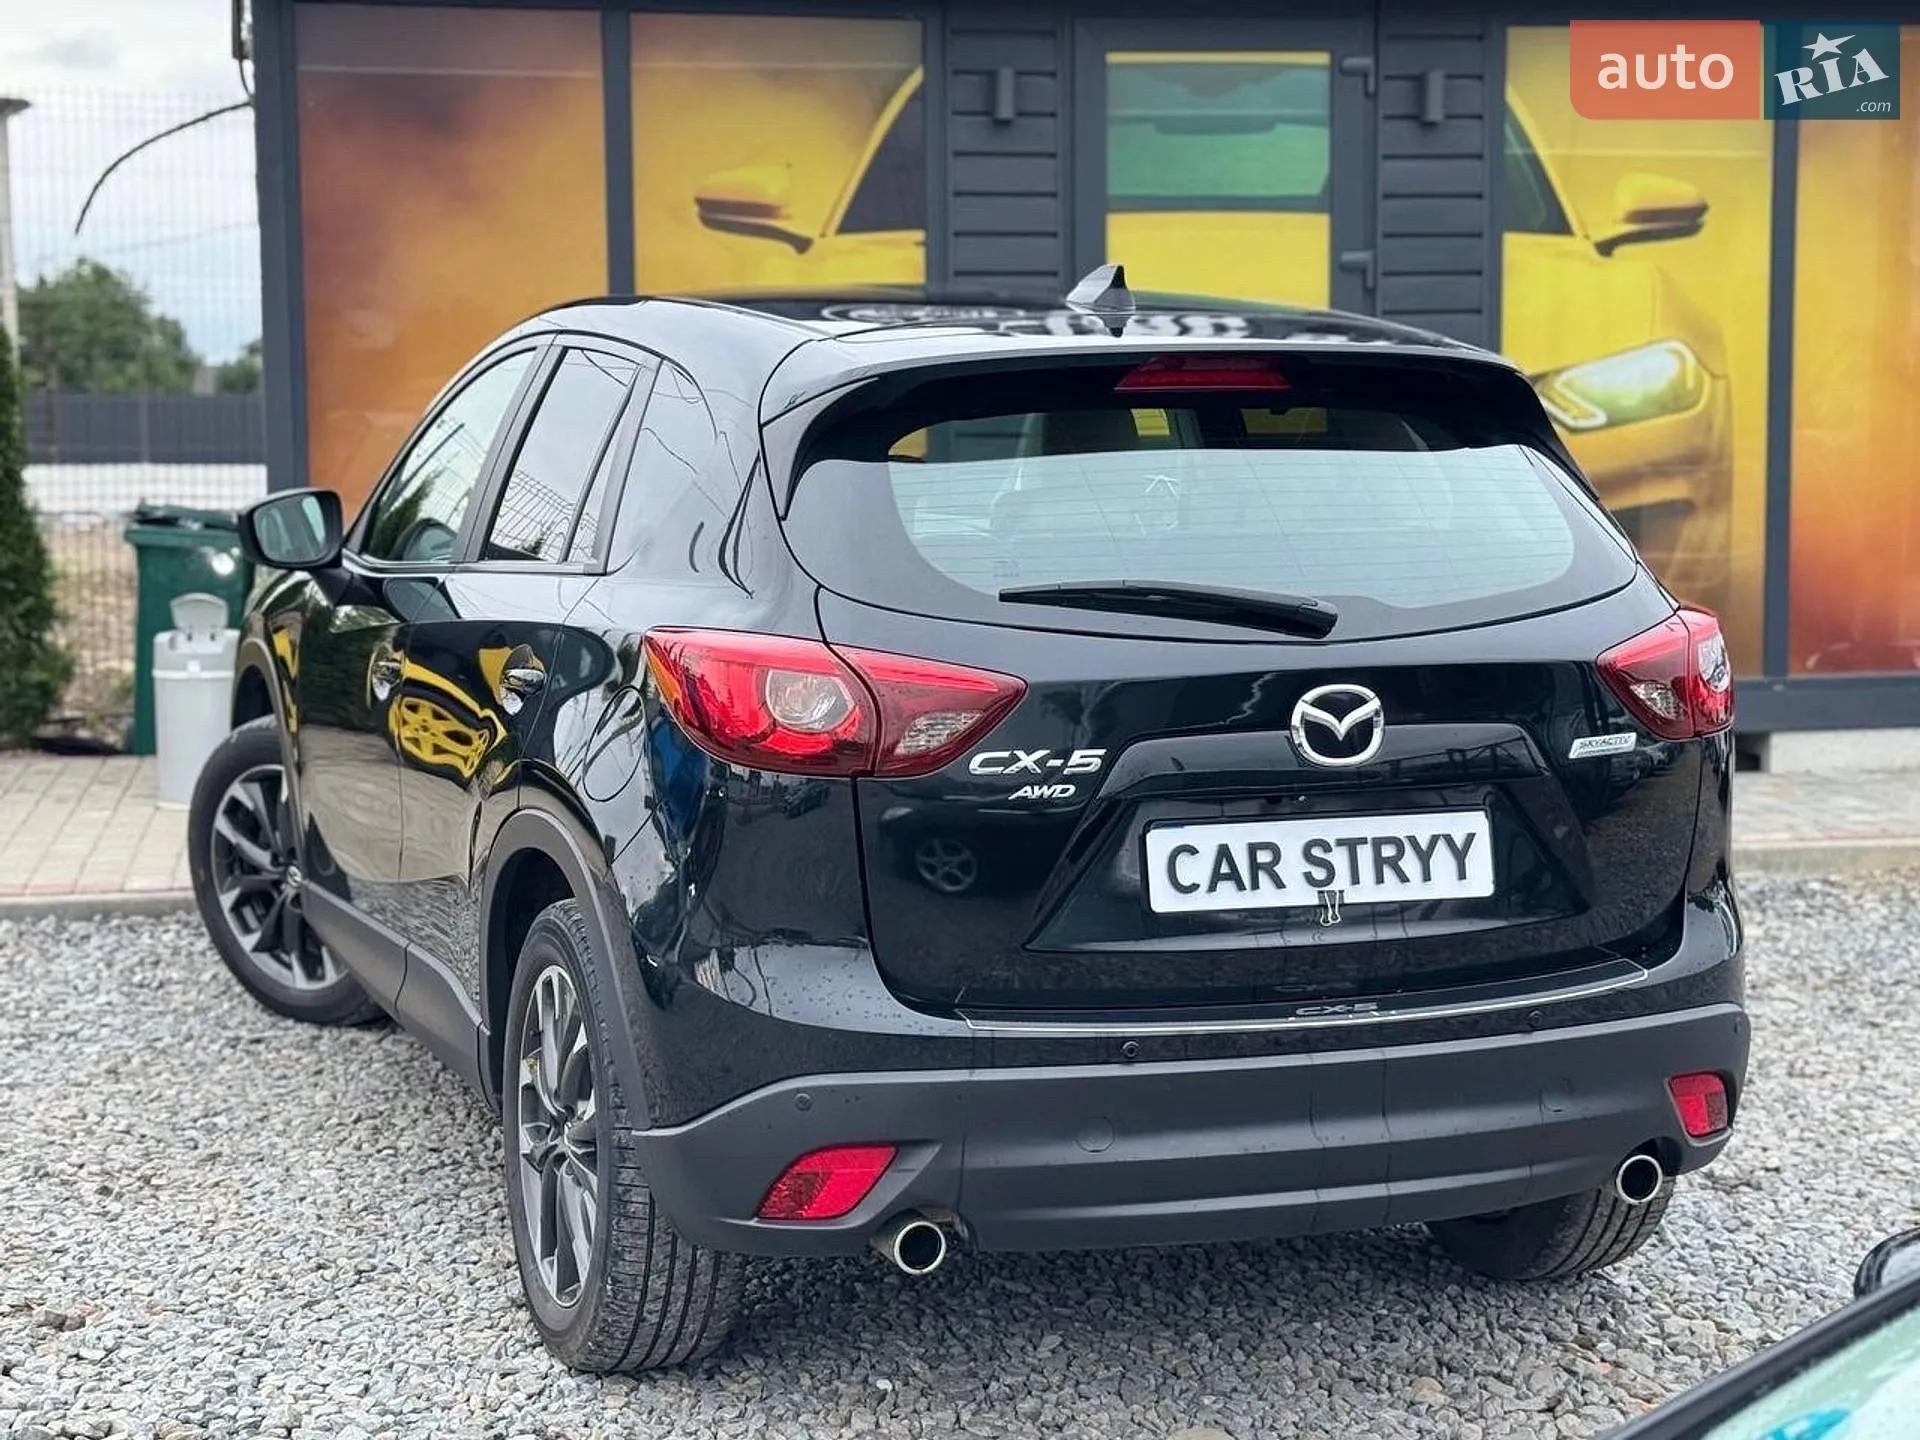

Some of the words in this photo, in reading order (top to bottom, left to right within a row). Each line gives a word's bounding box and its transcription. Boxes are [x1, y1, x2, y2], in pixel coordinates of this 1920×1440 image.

[1579, 735, 1632, 749] SKYACTIV
[968, 748, 1107, 775] CX-5
[1008, 784, 1076, 800] AWD
[1166, 841, 1287, 894] CAR
[1302, 832, 1477, 888] STRYY
